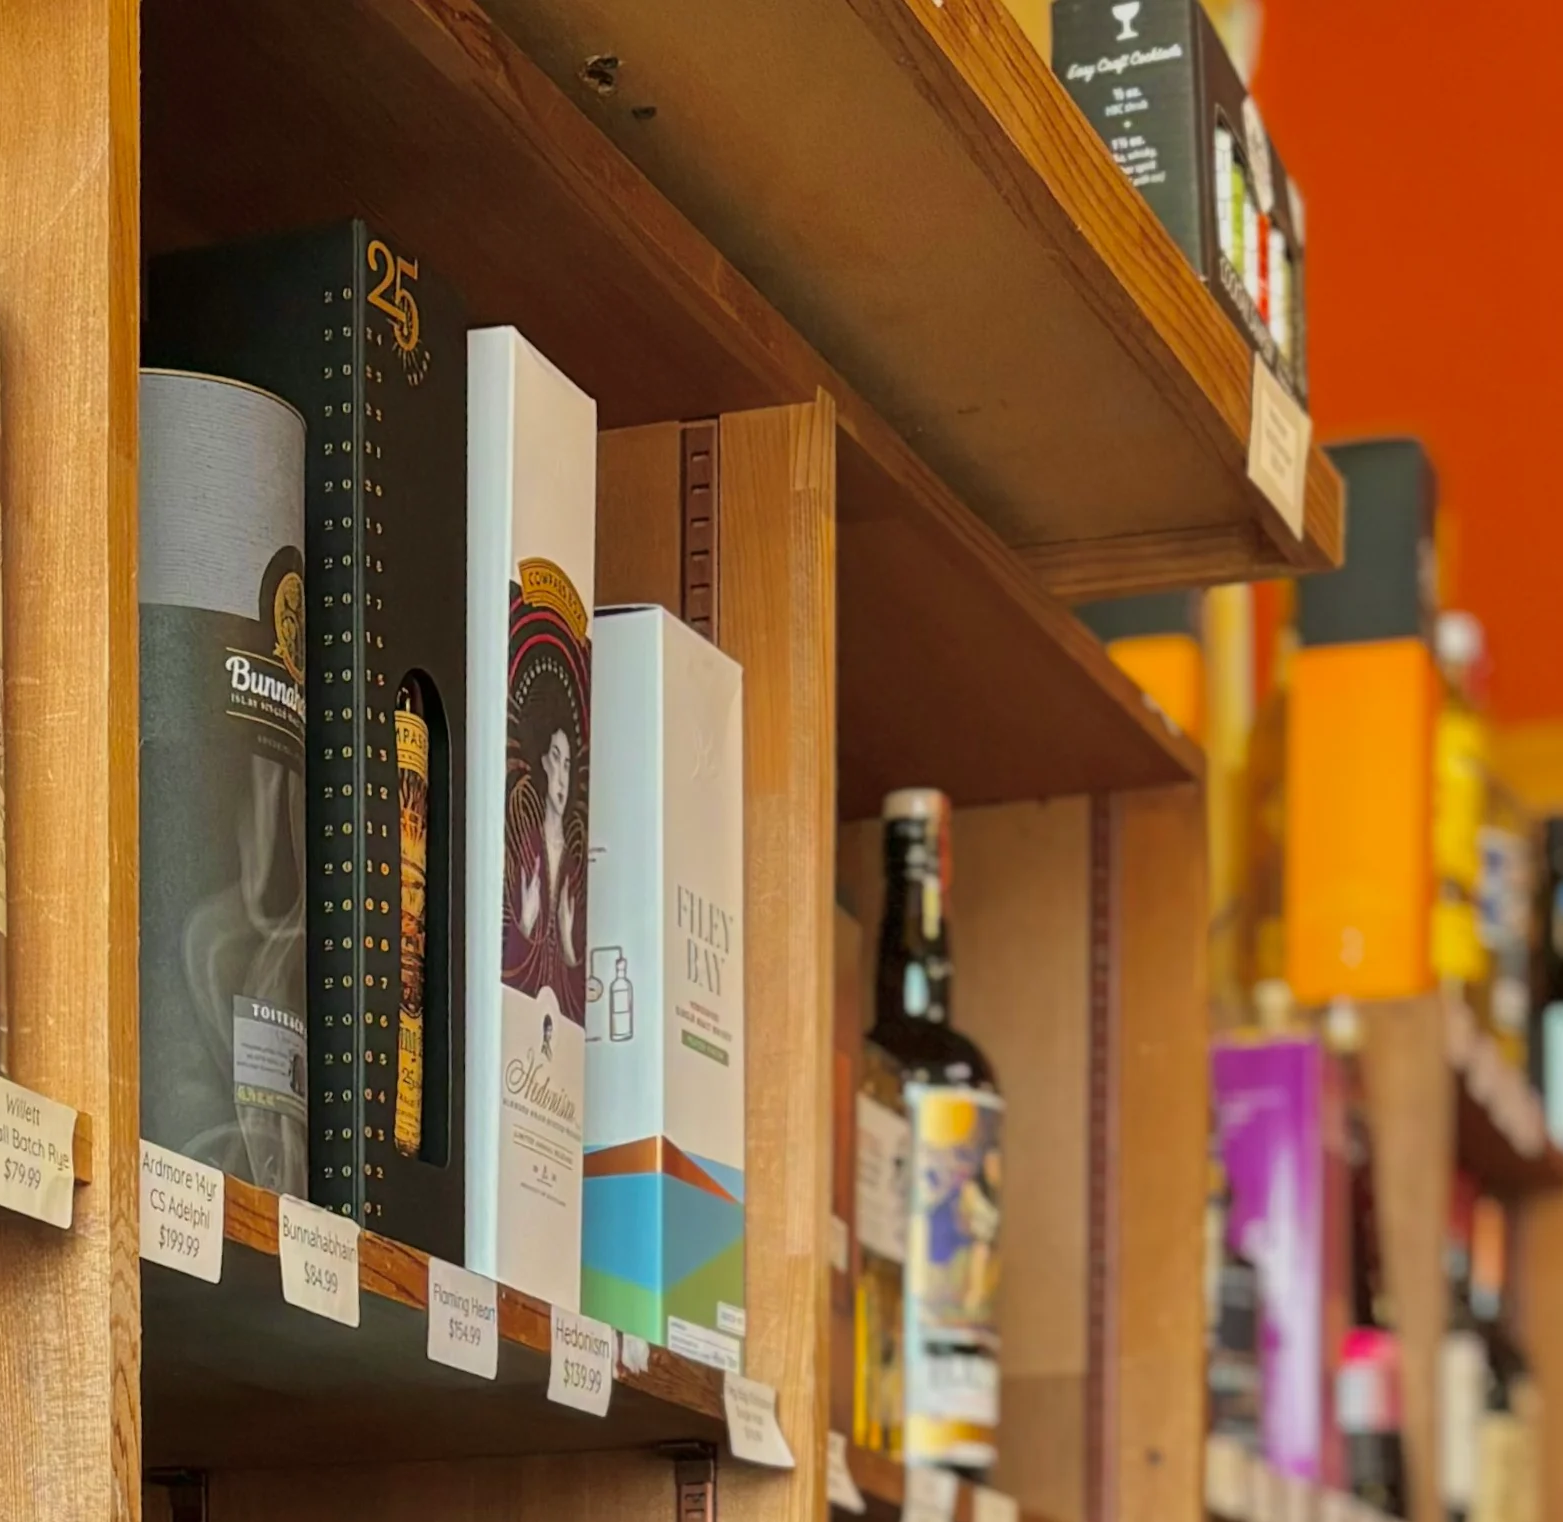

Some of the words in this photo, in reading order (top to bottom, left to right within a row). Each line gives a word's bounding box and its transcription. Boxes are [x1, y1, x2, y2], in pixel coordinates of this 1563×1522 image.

[366, 240, 419, 351] 25
[677, 884, 734, 955] FILEY
[687, 937, 725, 997] BAY
[5, 1093, 42, 1127] Willett
[12, 1126, 46, 1161] Batch
[48, 1142, 70, 1172] Rye
[3, 1157, 42, 1190] $79.99
[142, 1150, 194, 1189] Ardmore
[194, 1171, 218, 1203] 14yr
[149, 1188, 167, 1212] CS
[168, 1194, 210, 1231] Adelphi
[158, 1223, 201, 1259] $199.99
[282, 1214, 357, 1264] Bunnahabhain
[303, 1261, 339, 1296] $84.99
[555, 1317, 610, 1360] Hedonism
[563, 1359, 603, 1395] $139.99
